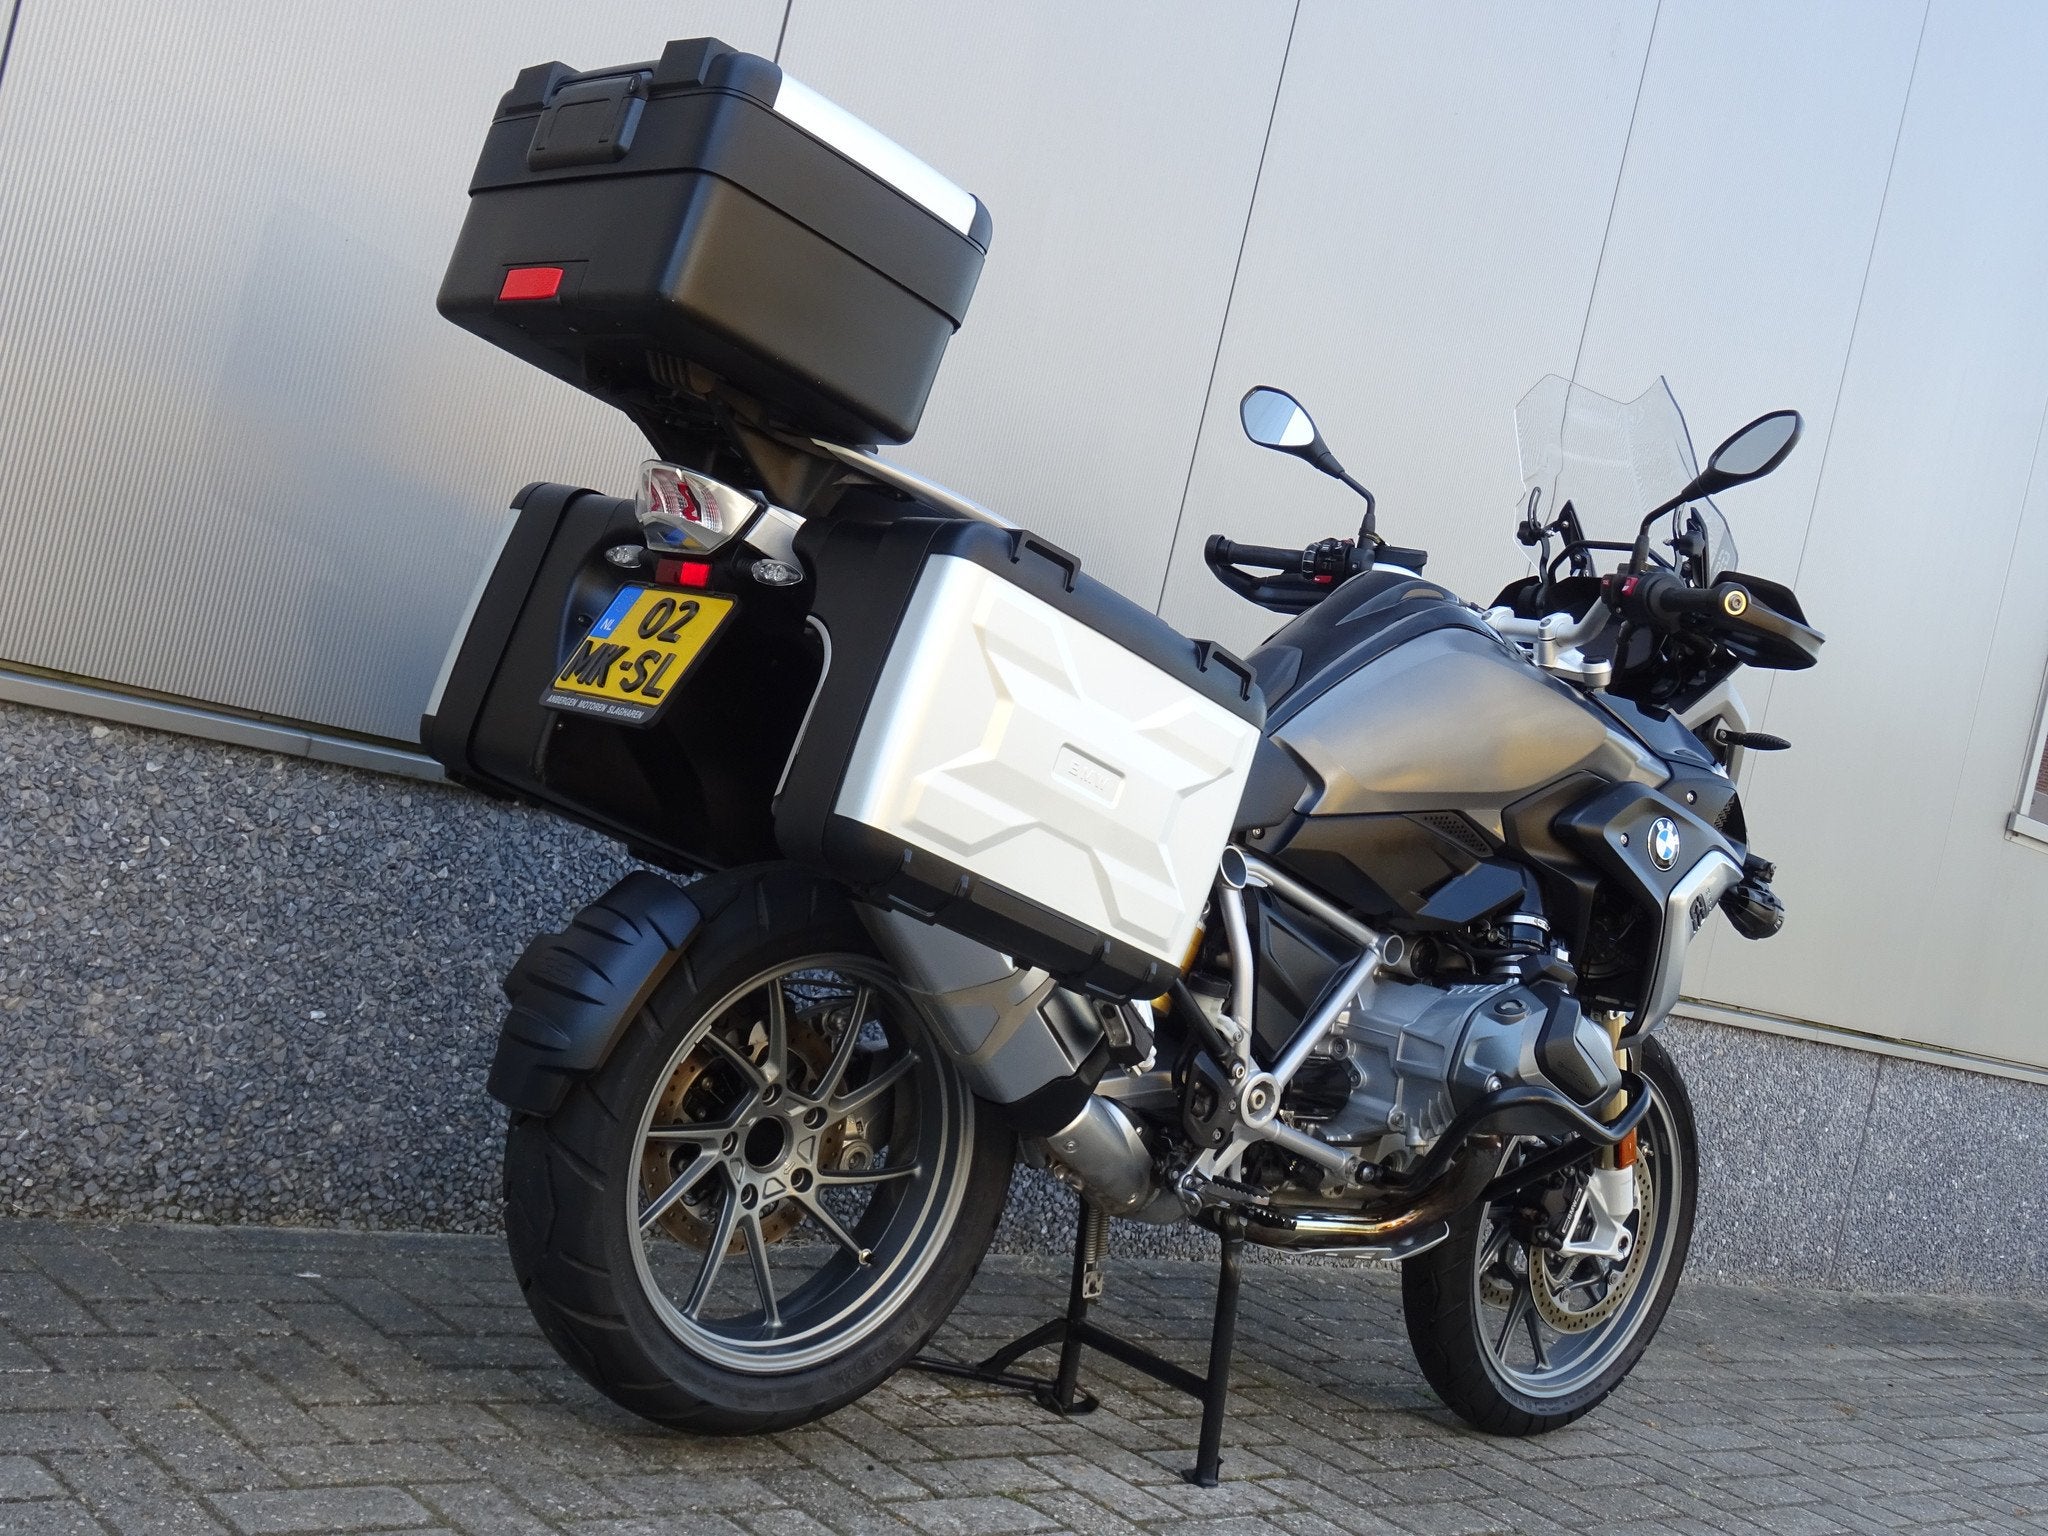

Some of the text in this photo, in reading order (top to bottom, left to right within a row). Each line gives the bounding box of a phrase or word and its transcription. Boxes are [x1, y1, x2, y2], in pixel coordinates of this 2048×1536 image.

[600, 618, 615, 631] NL
[638, 598, 700, 643] 02
[560, 640, 677, 698] MK-SL
[578, 700, 608, 712] MOTOREN
[607, 705, 645, 720] SLAGHAREN
